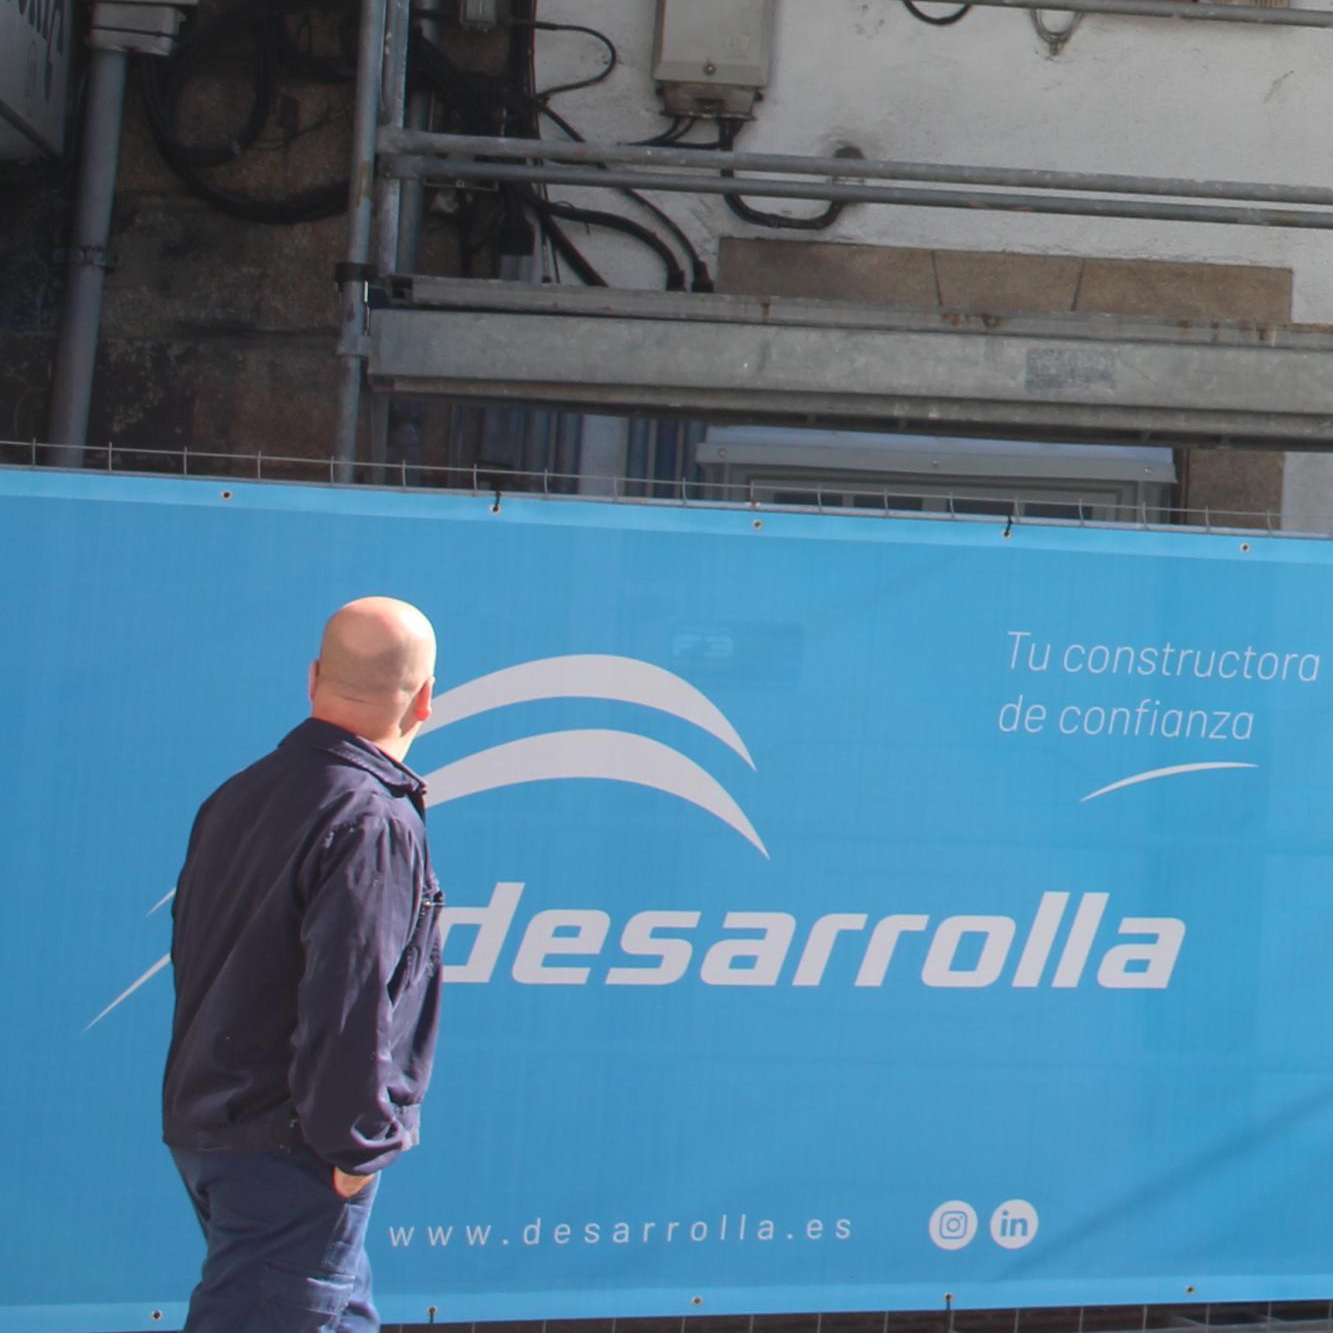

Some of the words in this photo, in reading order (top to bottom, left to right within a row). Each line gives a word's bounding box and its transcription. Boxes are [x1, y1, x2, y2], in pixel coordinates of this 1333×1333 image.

[1007, 630, 1051, 671] Tu
[1062, 642, 1321, 682] constructora
[997, 694, 1047, 733] de
[1058, 699, 1255, 741] confianza
[440, 882, 1186, 989] desarrolla
[388, 1213, 853, 1248] www.desarrolla.es
